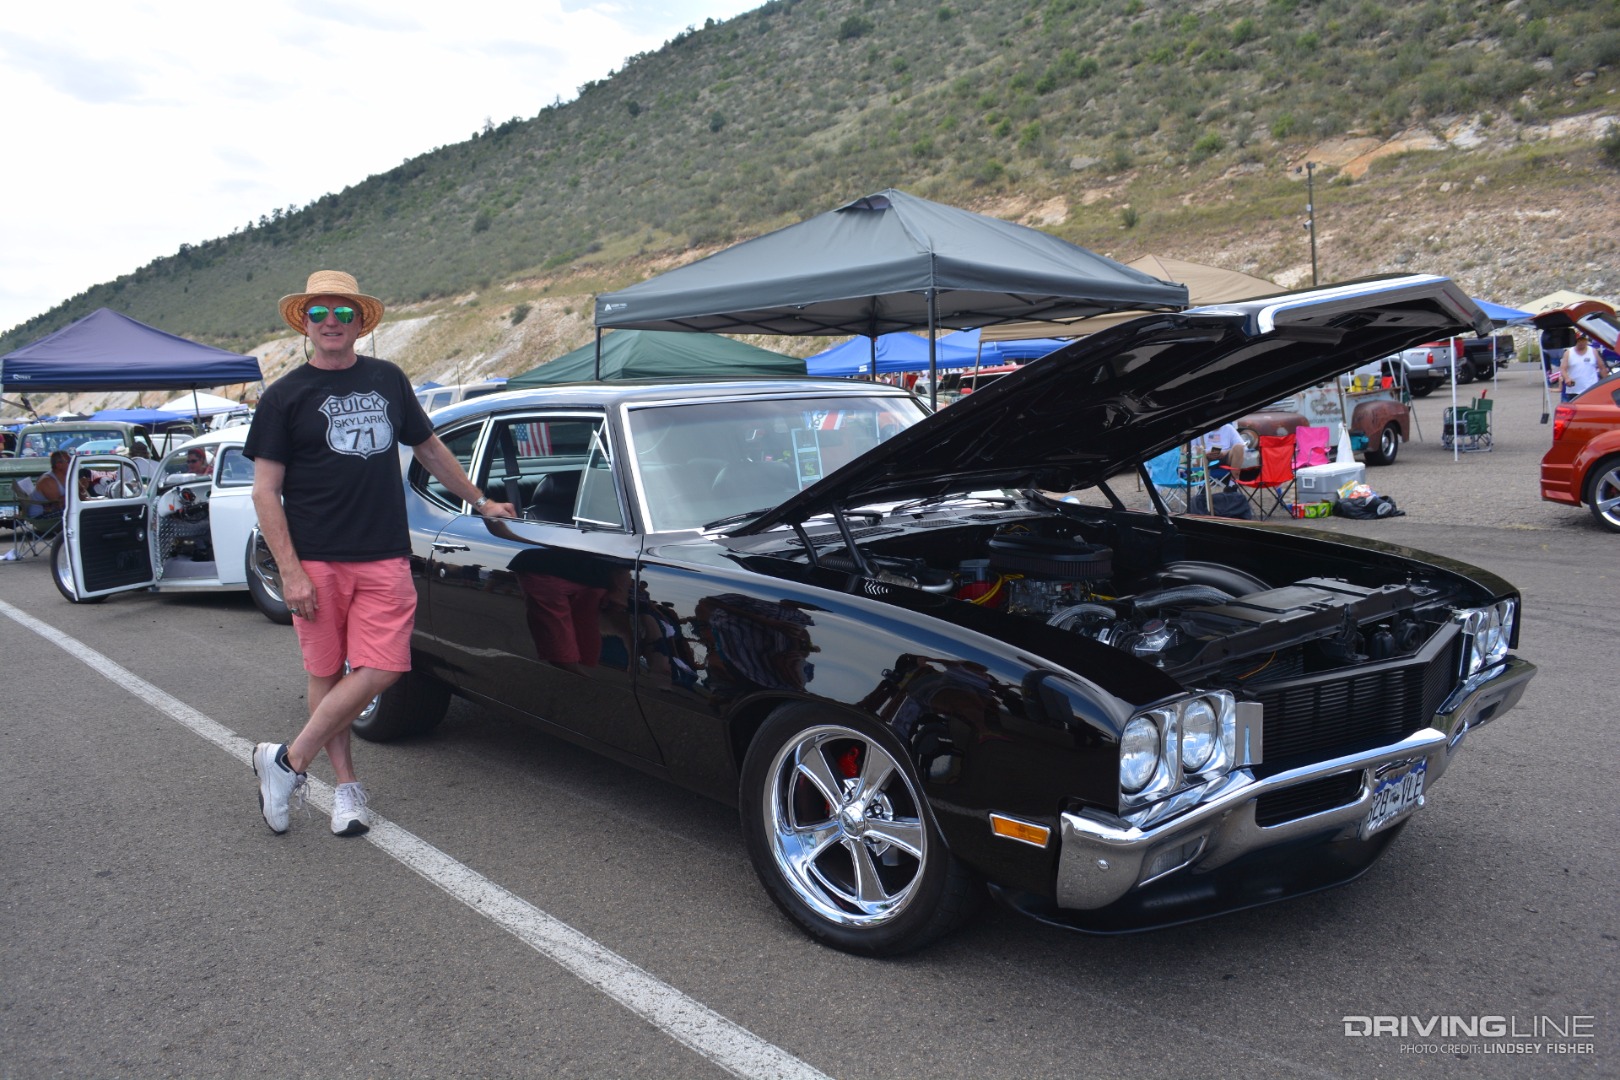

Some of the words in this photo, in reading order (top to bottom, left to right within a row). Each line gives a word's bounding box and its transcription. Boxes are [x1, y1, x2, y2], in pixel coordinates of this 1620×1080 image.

[327, 397, 384, 414] BUICK
[334, 415, 385, 428] SKYLARK
[346, 427, 376, 449] 71
